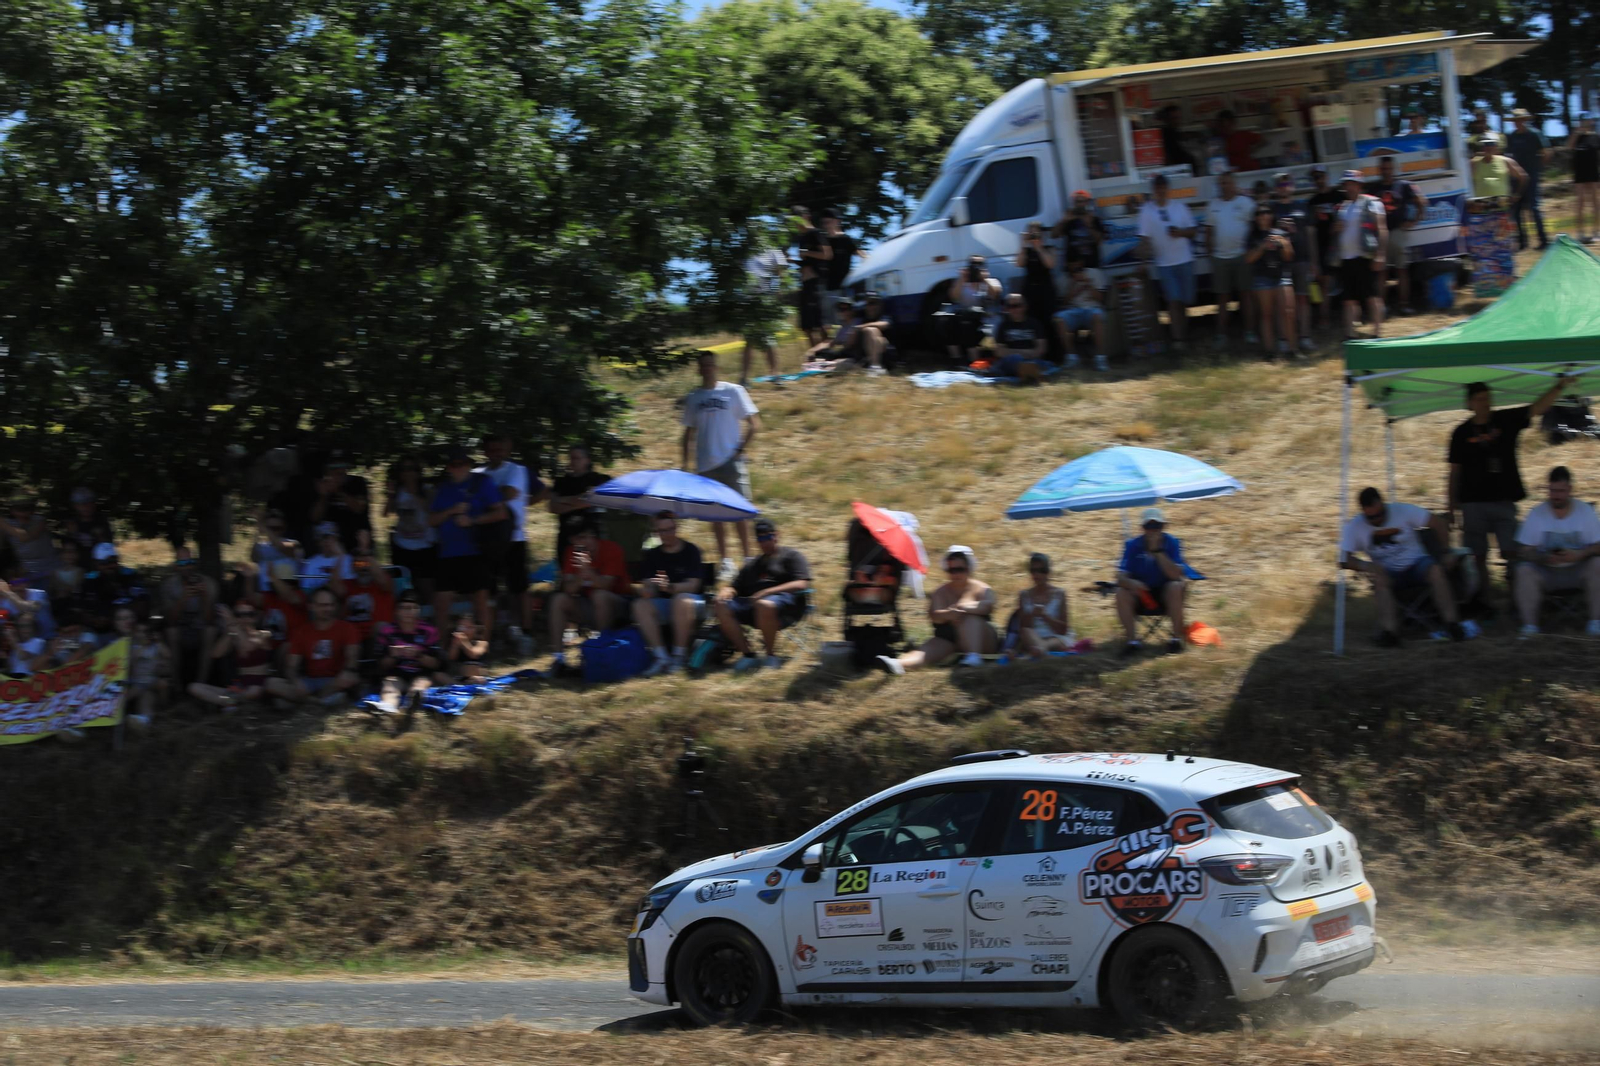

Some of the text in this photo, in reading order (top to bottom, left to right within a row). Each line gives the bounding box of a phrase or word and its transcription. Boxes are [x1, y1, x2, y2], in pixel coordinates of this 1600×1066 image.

[1019, 789, 1058, 821] 28
[1060, 806, 1114, 820] F.Pérez
[1057, 821, 1116, 836] A.Pérez
[837, 869, 869, 893] 28
[872, 872, 892, 883] La
[1085, 870, 1200, 901] PROCARS
[1124, 896, 1160, 906] MOTOR
[970, 936, 1011, 948] PAZOS
[878, 963, 916, 975] BERTO
[1031, 963, 1070, 975] CHAPI
